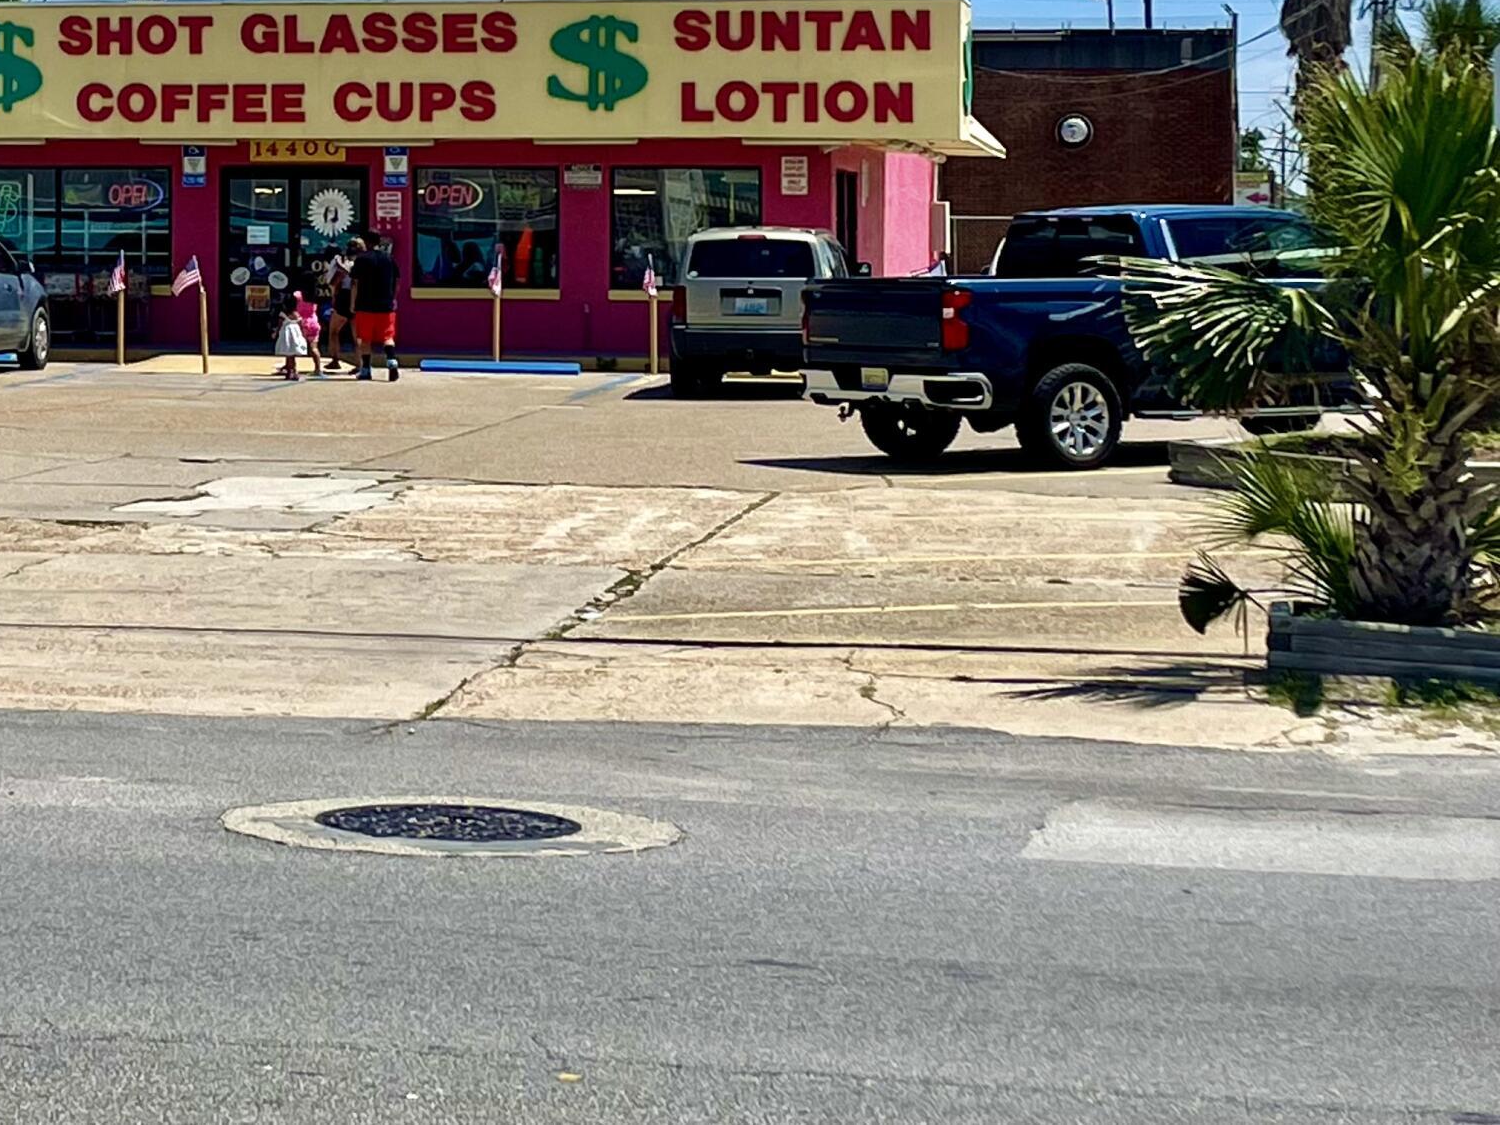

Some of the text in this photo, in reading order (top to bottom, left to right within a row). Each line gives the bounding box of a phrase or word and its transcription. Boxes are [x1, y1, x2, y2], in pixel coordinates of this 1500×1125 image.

[58, 10, 517, 56] SHOT GLASSES
[673, 9, 931, 52] SUNTAN
[76, 81, 497, 124] COFFEE CUPS
[680, 80, 914, 124] LOTION
[253, 140, 341, 157] 14400
[425, 184, 473, 206] OPEN
